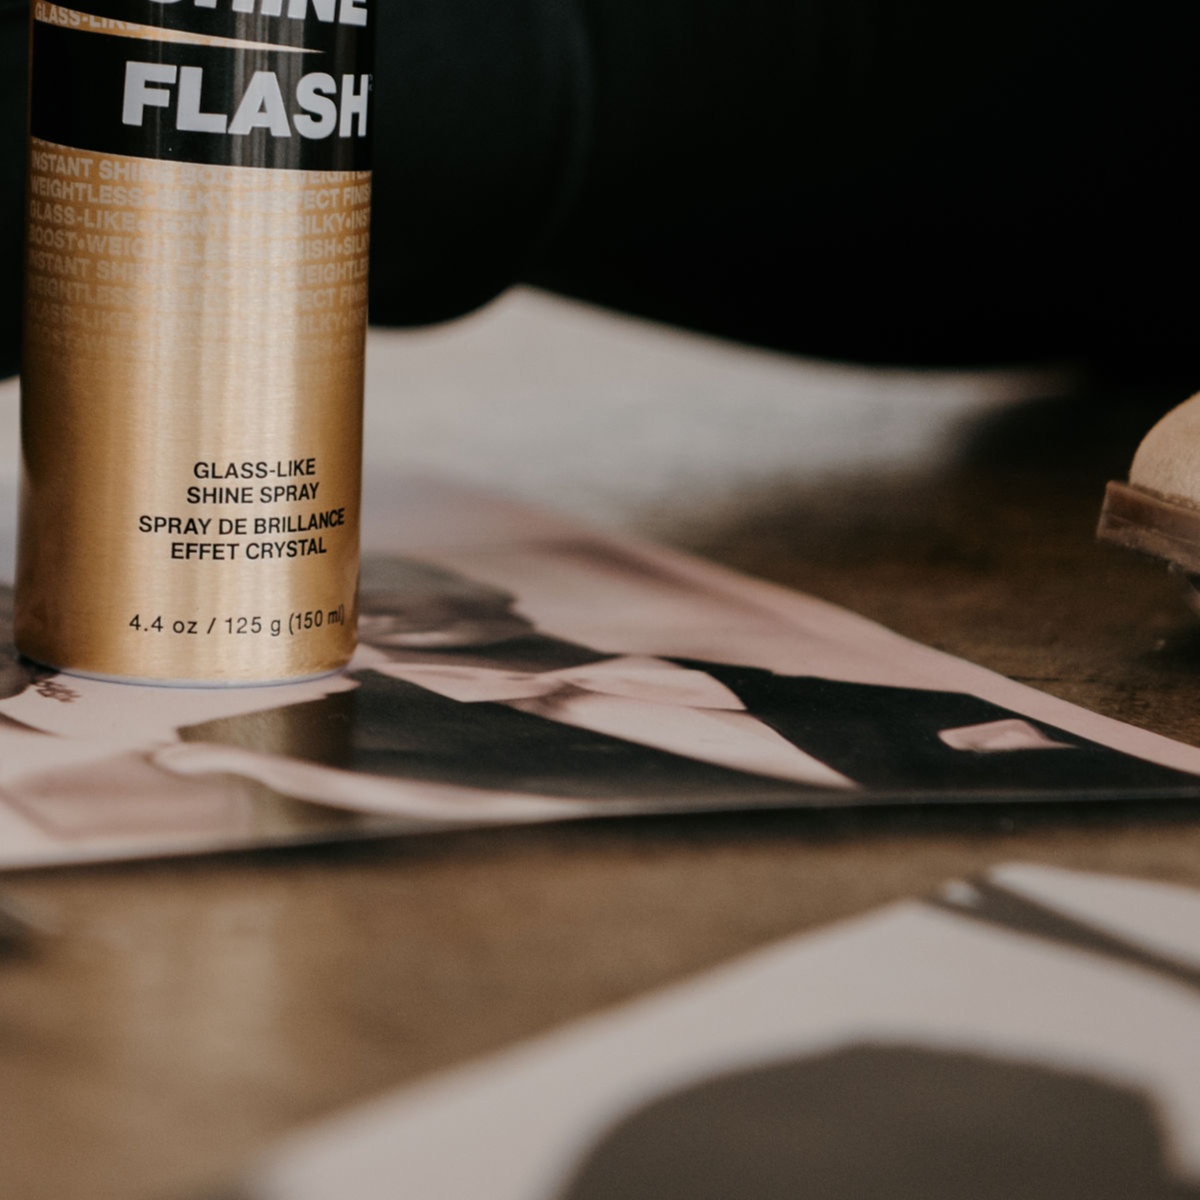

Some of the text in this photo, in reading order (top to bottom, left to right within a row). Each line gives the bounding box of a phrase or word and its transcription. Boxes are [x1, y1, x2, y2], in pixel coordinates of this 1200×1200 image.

[122, 60, 369, 139] FLASH
[193, 458, 316, 480] GLASS-LIKE
[186, 482, 320, 504] SHINE SPRAY
[138, 508, 345, 536] SPRAY DE BRILLANCE
[170, 537, 327, 560] EFFET CRYSTAL
[129, 614, 164, 632] 4.4
[172, 620, 198, 635] oz
[207, 617, 217, 635] /
[225, 617, 262, 635] 125
[270, 619, 281, 637] g
[289, 609, 324, 635] (150
